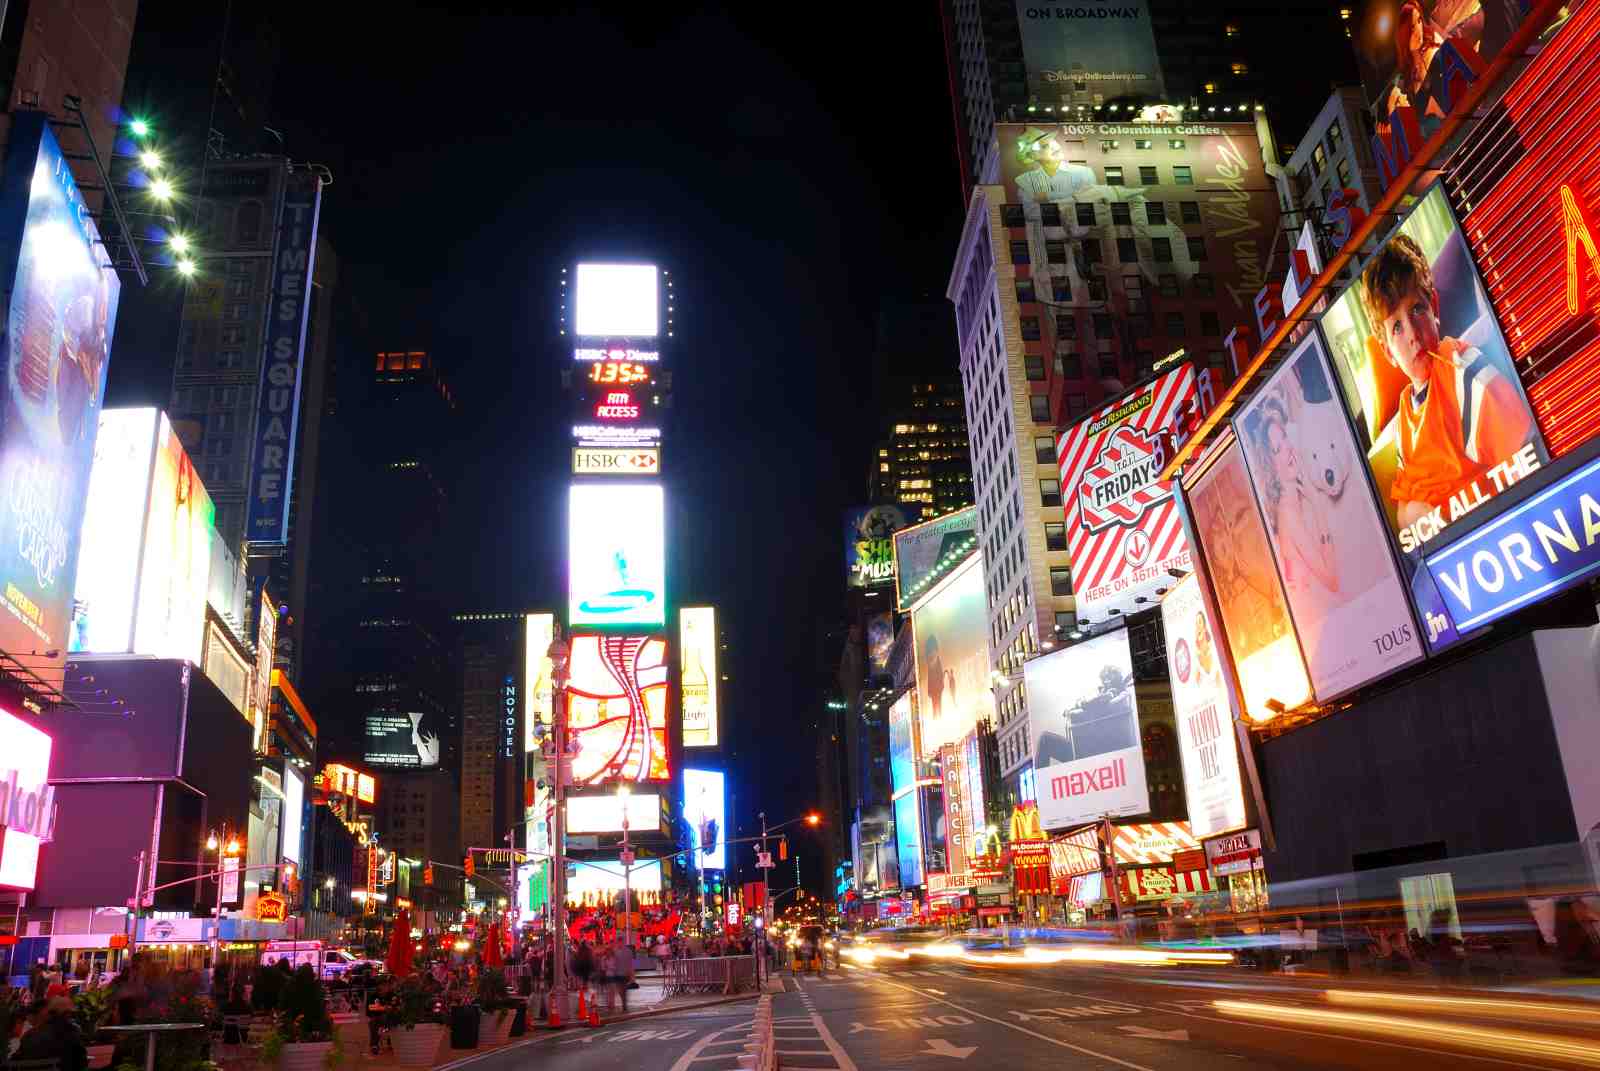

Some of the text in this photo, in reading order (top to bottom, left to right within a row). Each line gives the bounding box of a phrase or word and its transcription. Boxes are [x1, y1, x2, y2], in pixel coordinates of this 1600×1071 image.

[1026, 7, 1140, 20] ON BROADWAY
[1063, 124, 1221, 135] 100% Colombian Coffee
[259, 203, 311, 497] TIMES SQUARE
[576, 454, 628, 468] HSBC
[1399, 441, 1542, 553] SICK ALL THE
[1085, 585, 1113, 604] HERE
[1114, 577, 1129, 591] ON
[1132, 564, 1159, 582] 46TH
[1372, 624, 1412, 655] TOUS
[505, 686, 515, 757] NOVOTEL
[1051, 758, 1127, 800] maxell
[946, 755, 963, 846] PALACE
